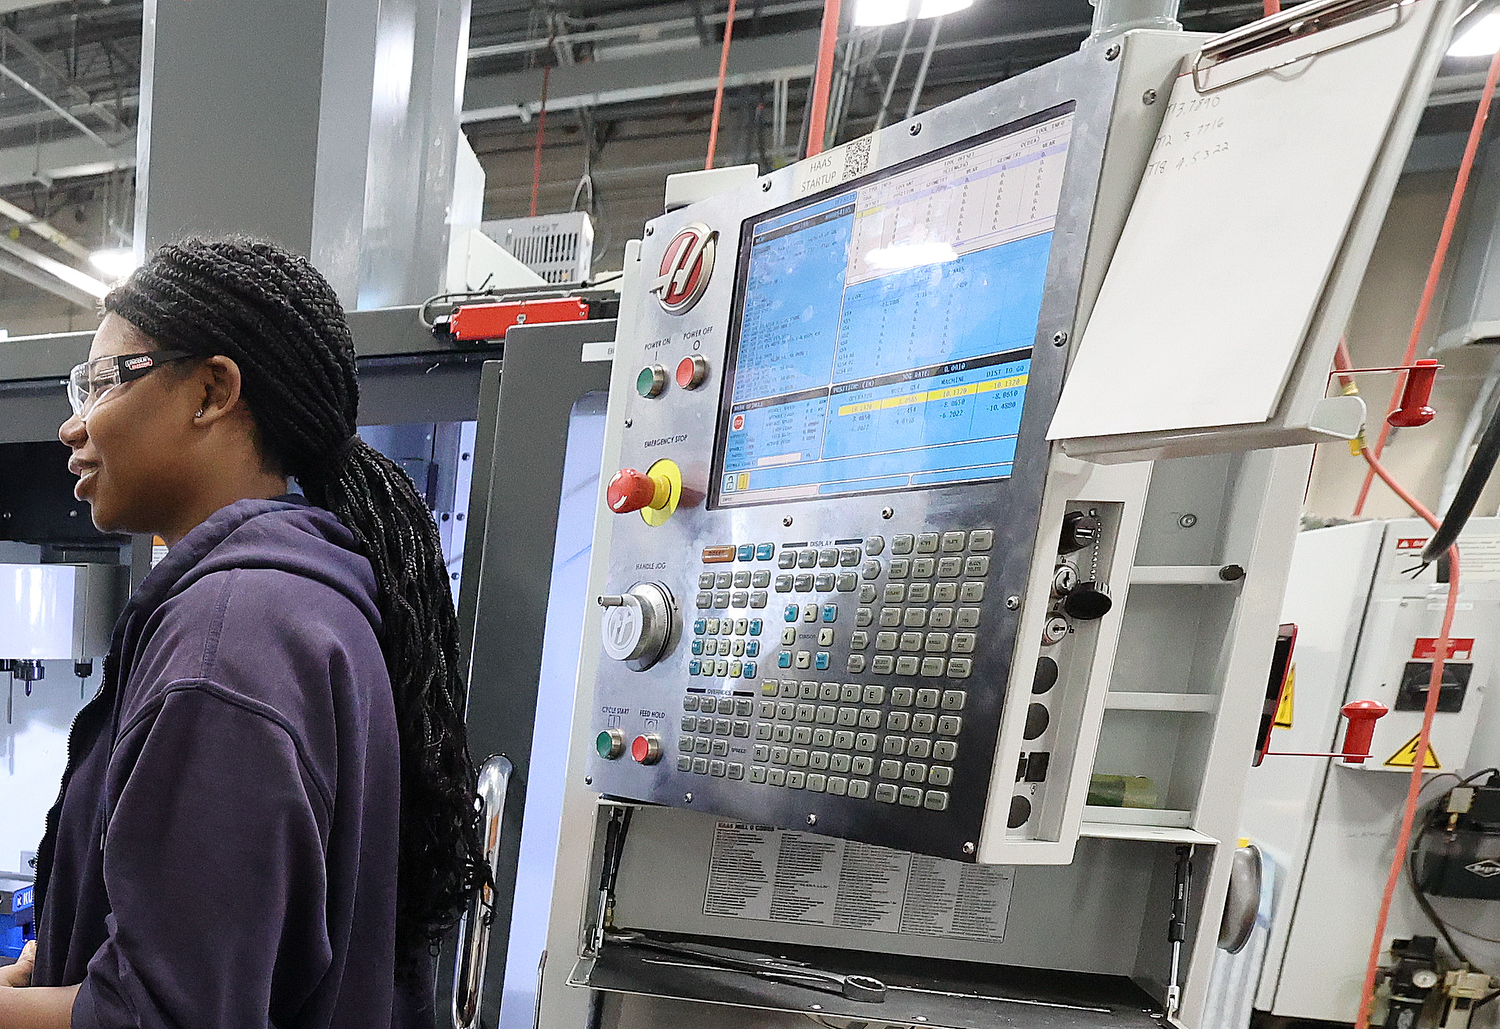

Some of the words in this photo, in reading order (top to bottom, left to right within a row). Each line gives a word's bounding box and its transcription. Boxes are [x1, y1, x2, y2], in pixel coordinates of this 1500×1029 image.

[810, 156, 832, 172] HAAS
[801, 171, 836, 192] STARTUP
[683, 329, 701, 340] POWER
[703, 326, 713, 335] OFF
[644, 341, 661, 351] POWER
[662, 338, 671, 346] ON
[986, 369, 1001, 377] DIST
[644, 437, 674, 448] EMERGENCY
[675, 434, 688, 442] STOP
[602, 706, 616, 714] CYCLE
